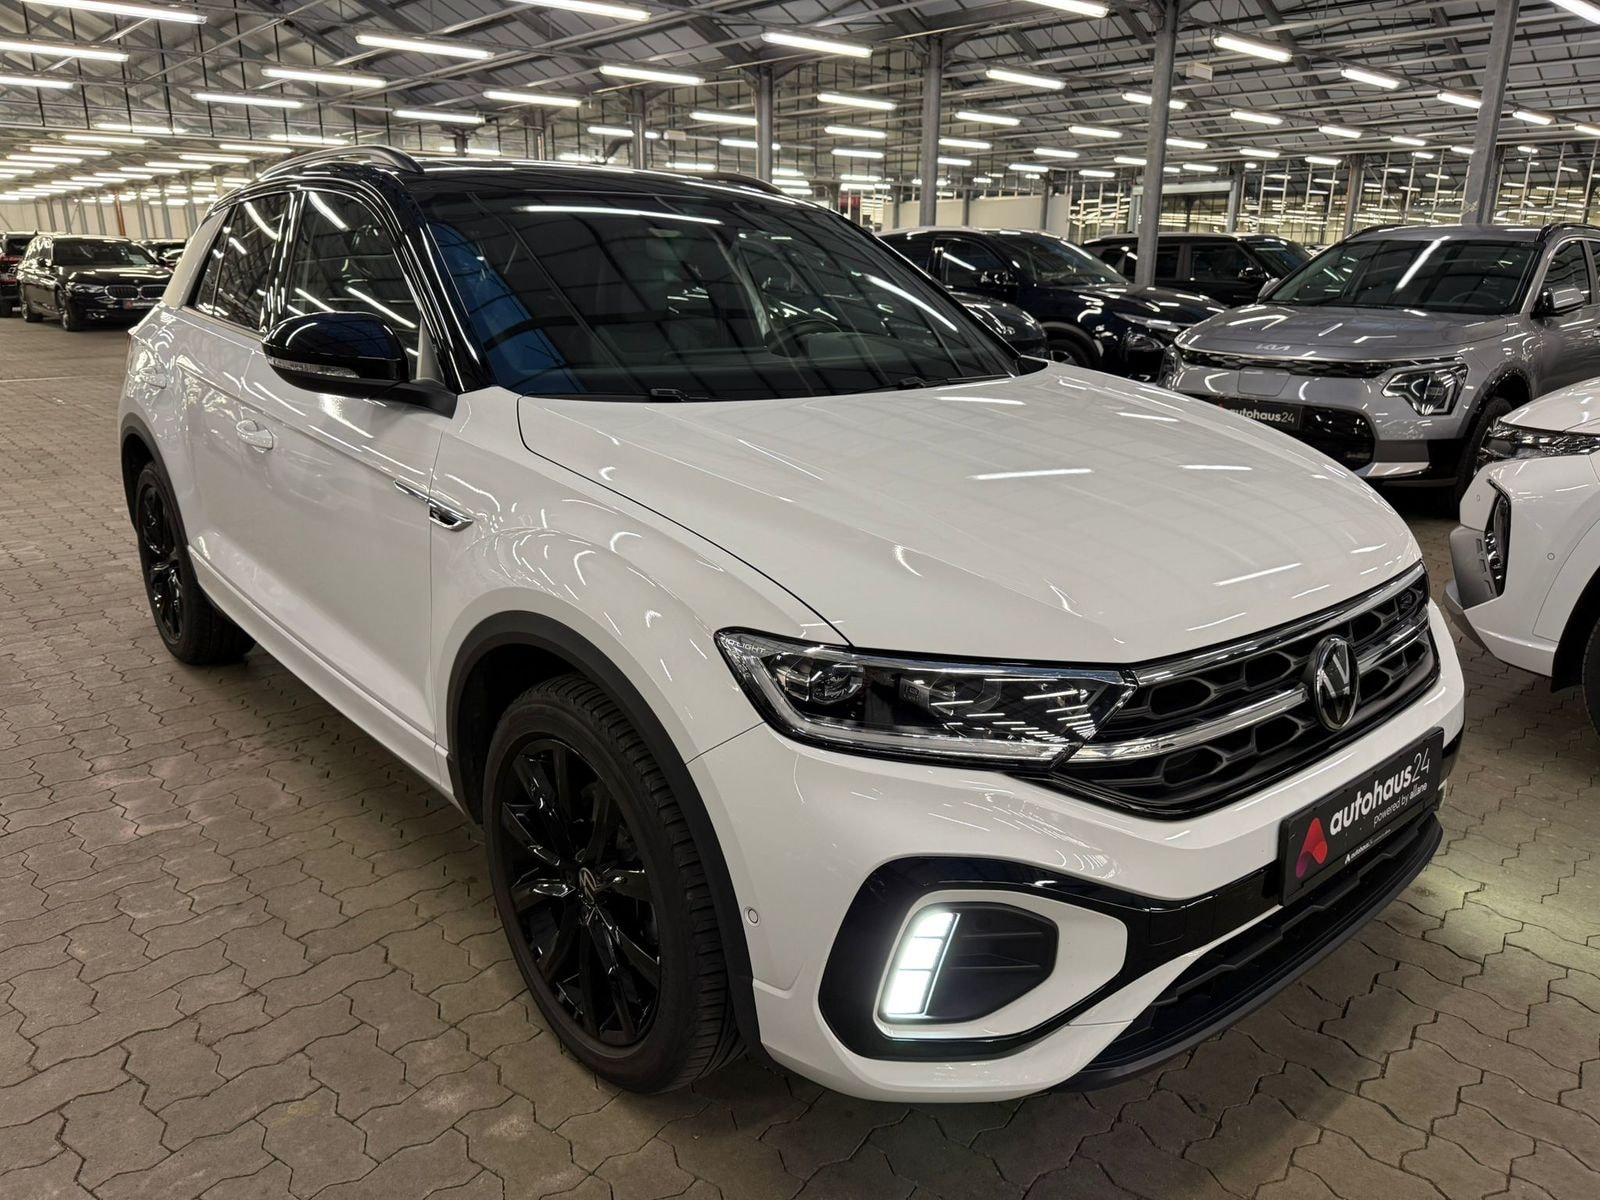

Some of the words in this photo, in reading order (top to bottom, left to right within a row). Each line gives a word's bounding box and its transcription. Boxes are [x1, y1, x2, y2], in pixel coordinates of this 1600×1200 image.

[1330, 748, 1430, 835] autohaus24
[1374, 796, 1400, 828] powered
[1401, 794, 1409, 806] by
